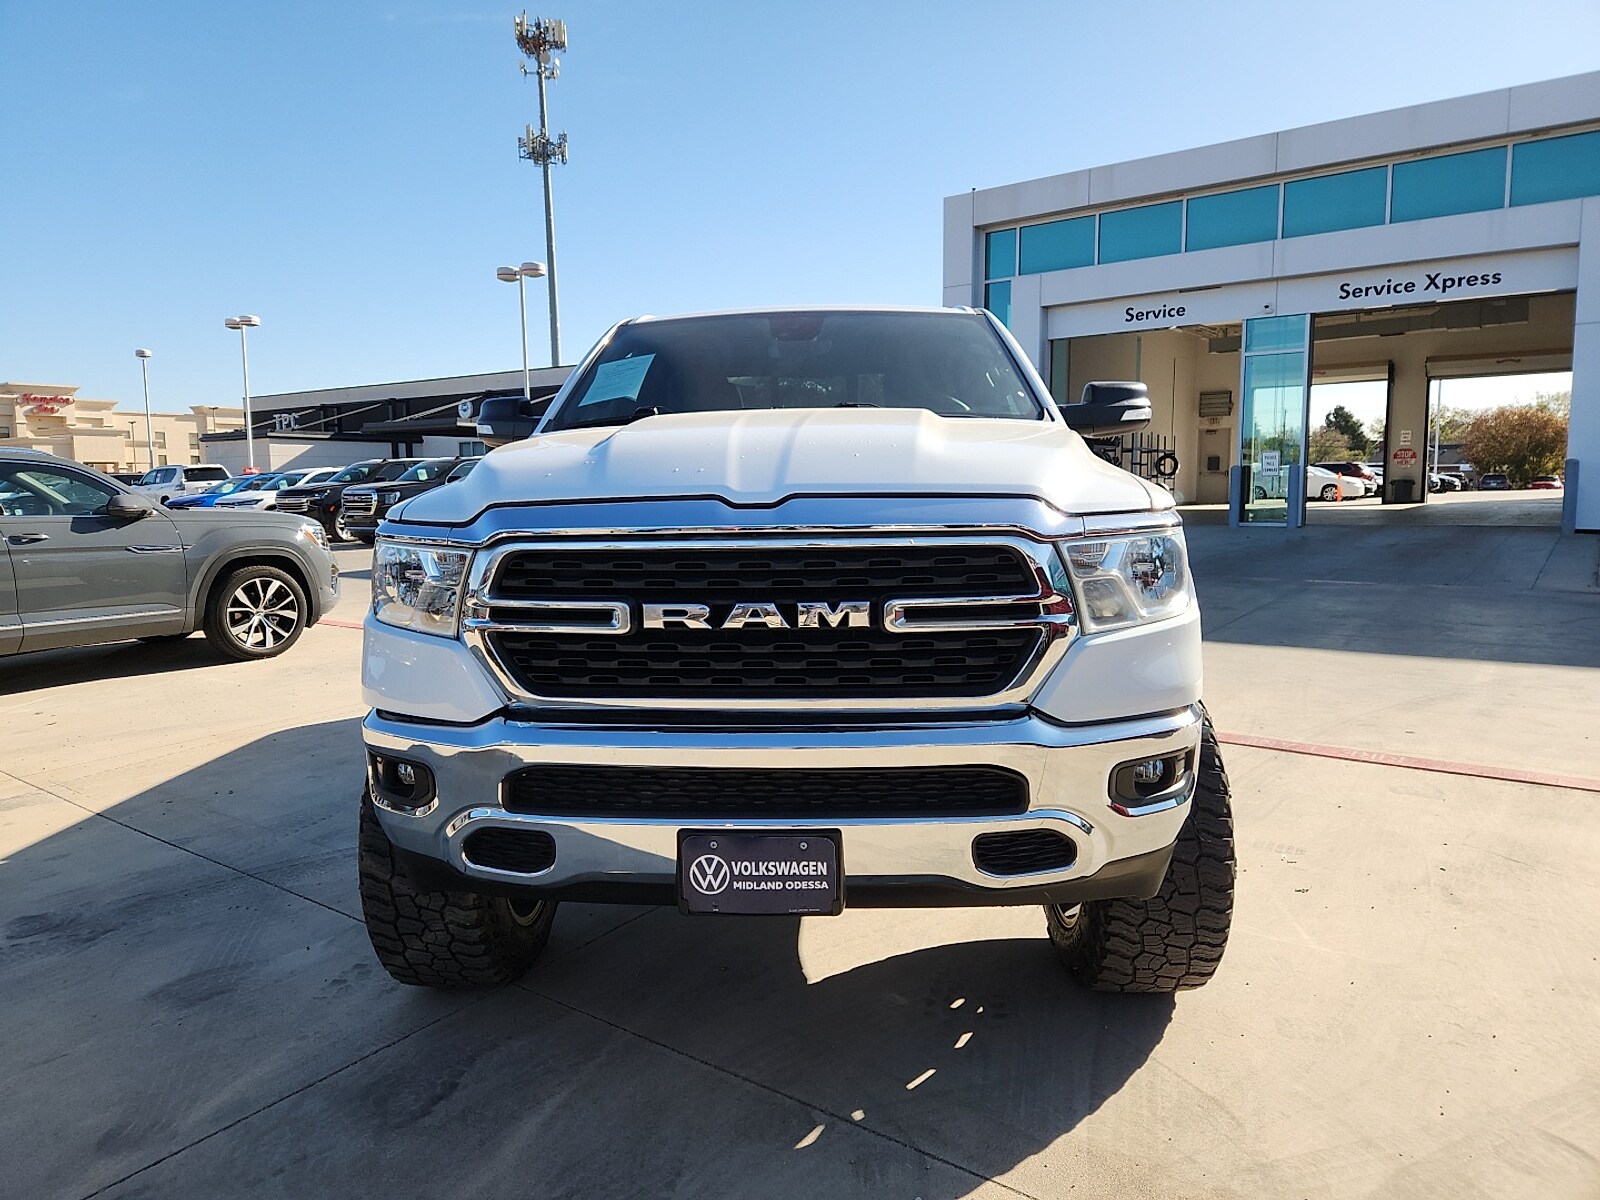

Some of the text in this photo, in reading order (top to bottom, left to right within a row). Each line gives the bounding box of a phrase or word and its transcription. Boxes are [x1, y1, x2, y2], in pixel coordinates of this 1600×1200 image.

[1339, 272, 1502, 299] Service Xpress
[1125, 304, 1186, 322] Service
[1396, 450, 1414, 459] STOP
[642, 602, 870, 629] RAM
[731, 861, 828, 876] VOLKSWAGEN
[733, 880, 829, 890] MIDLAND ODESSA
